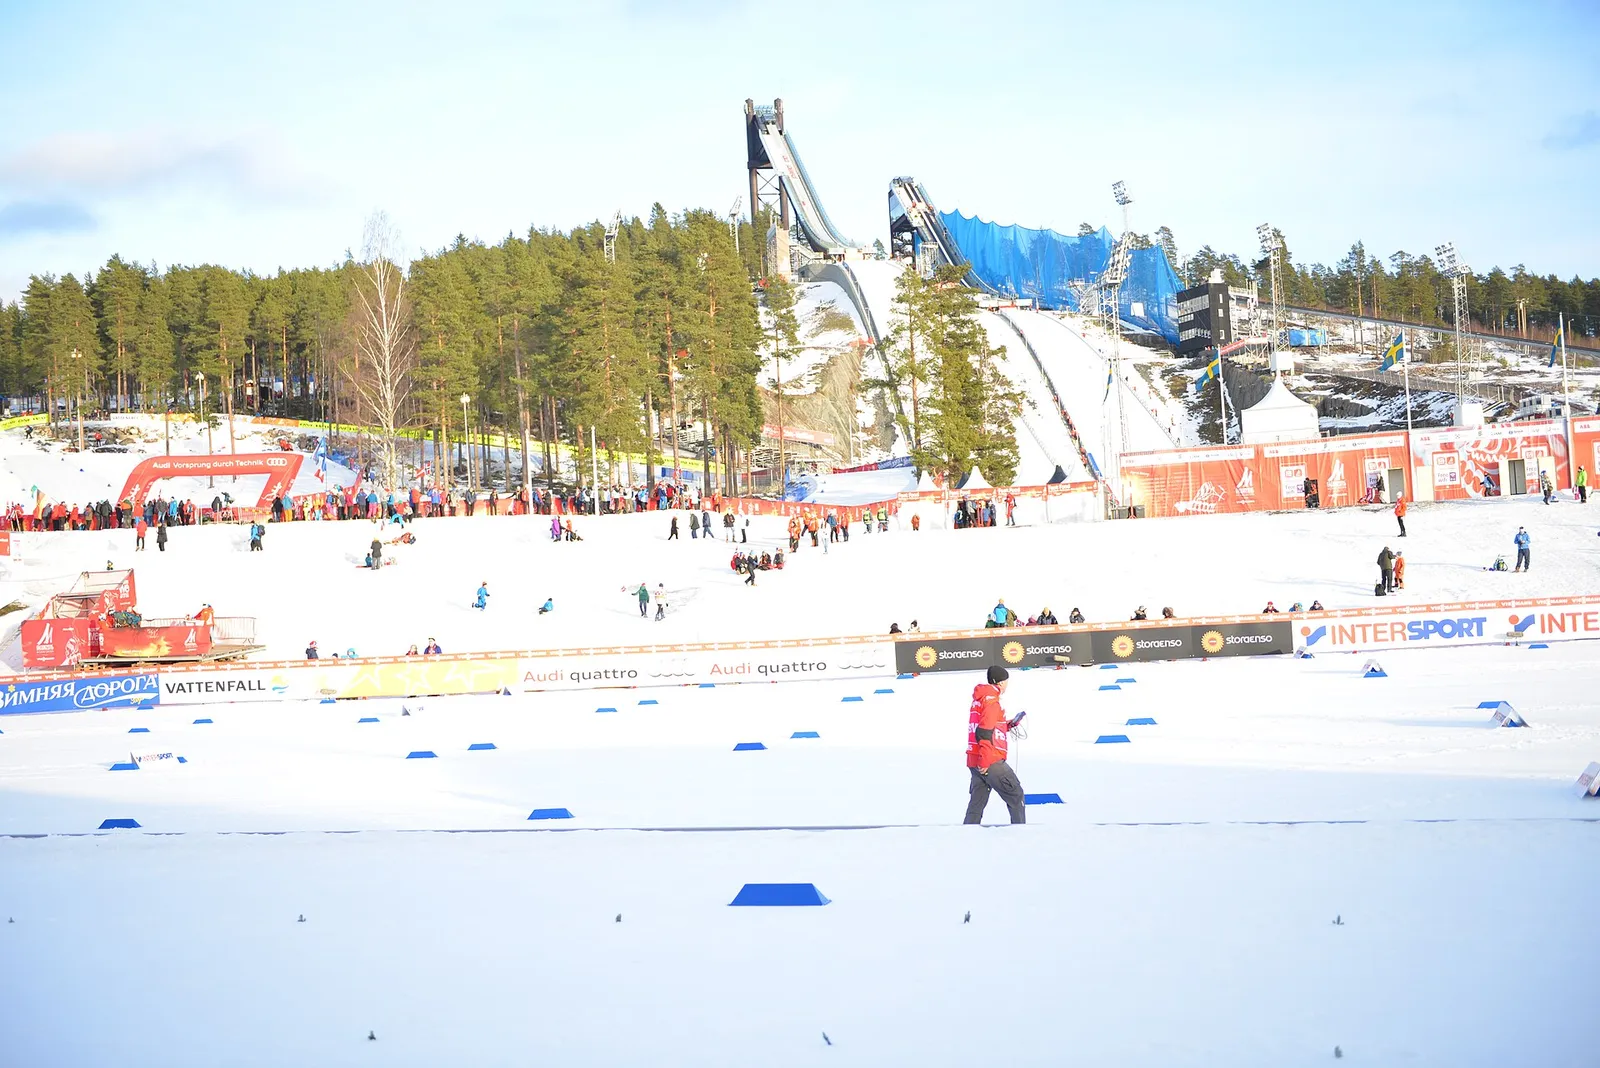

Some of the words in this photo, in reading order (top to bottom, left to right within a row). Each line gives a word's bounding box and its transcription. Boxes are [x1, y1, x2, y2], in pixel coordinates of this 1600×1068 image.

[152, 461, 171, 469] Audi
[173, 461, 212, 470] Vorsprung
[212, 460, 234, 468] durch
[235, 459, 264, 467] Technik
[1540, 611, 1600, 634] INTE
[1331, 617, 1487, 645] INTERSPORT
[1136, 639, 1182, 649] storaenso
[1226, 635, 1273, 645] storaenso
[939, 650, 984, 660] storaenso
[1026, 645, 1072, 655] storaenso
[524, 669, 564, 682] Audi
[570, 668, 638, 683] quattro
[710, 663, 751, 675] Audi
[757, 661, 827, 676] quattro
[81, 674, 158, 704] ДОРОГА
[165, 680, 266, 694] VATTENFALL
